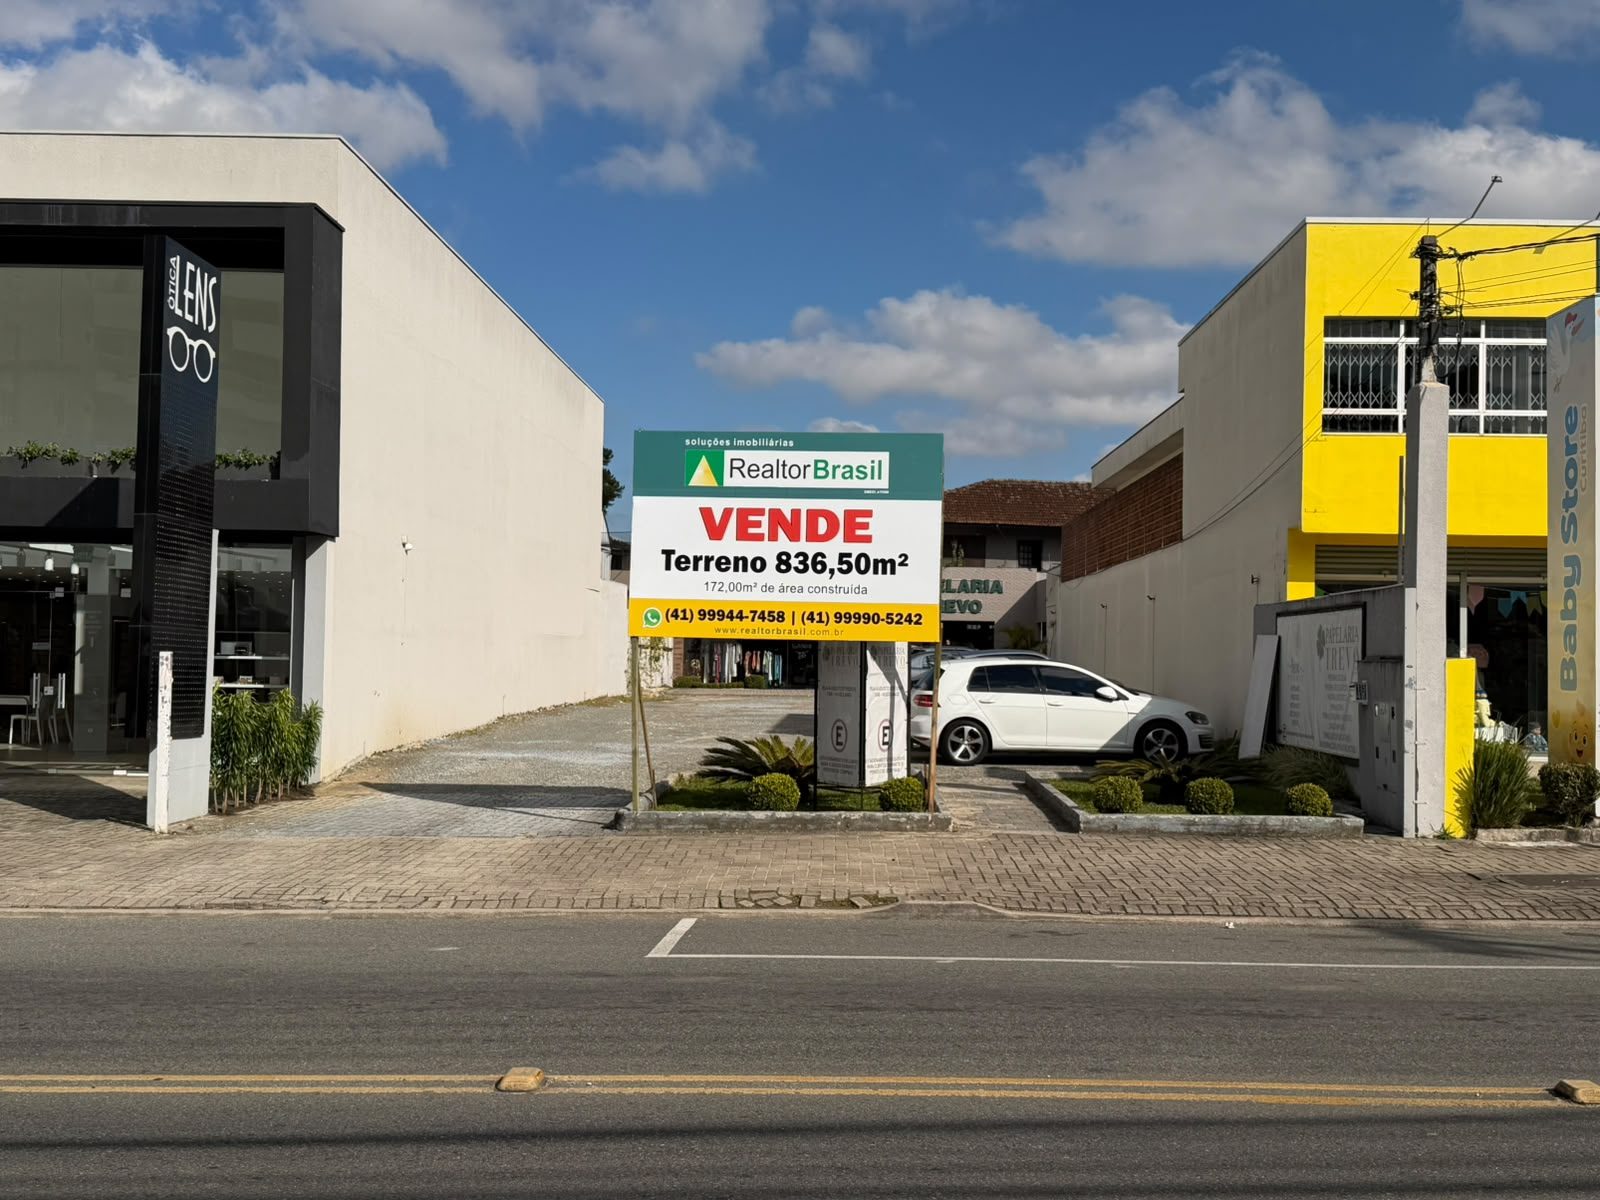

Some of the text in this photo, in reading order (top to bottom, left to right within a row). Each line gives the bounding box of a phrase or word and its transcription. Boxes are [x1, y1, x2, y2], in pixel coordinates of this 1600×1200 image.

[167, 256, 177, 310] ÓTICA
[174, 255, 217, 333] LENS
[685, 437, 795, 448] soluções imobiliárias
[1580, 405, 1588, 493] Curitiba
[729, 457, 883, 481] RealtorBrasil
[698, 506, 874, 543] VENDE
[1560, 405, 1582, 691] Baby Store
[661, 548, 909, 580] Terreno 836,50m²
[703, 581, 868, 595] 172,00m² de área construída
[665, 608, 694, 624] (41)
[697, 608, 786, 623] 99944-7458
[801, 610, 830, 627] (41)
[833, 611, 923, 626] 99990-5242
[941, 599, 983, 615] EVO
[714, 626, 845, 637] www.realtorbrasil.com.br
[836, 725, 844, 746] E
[882, 725, 891, 746] E
